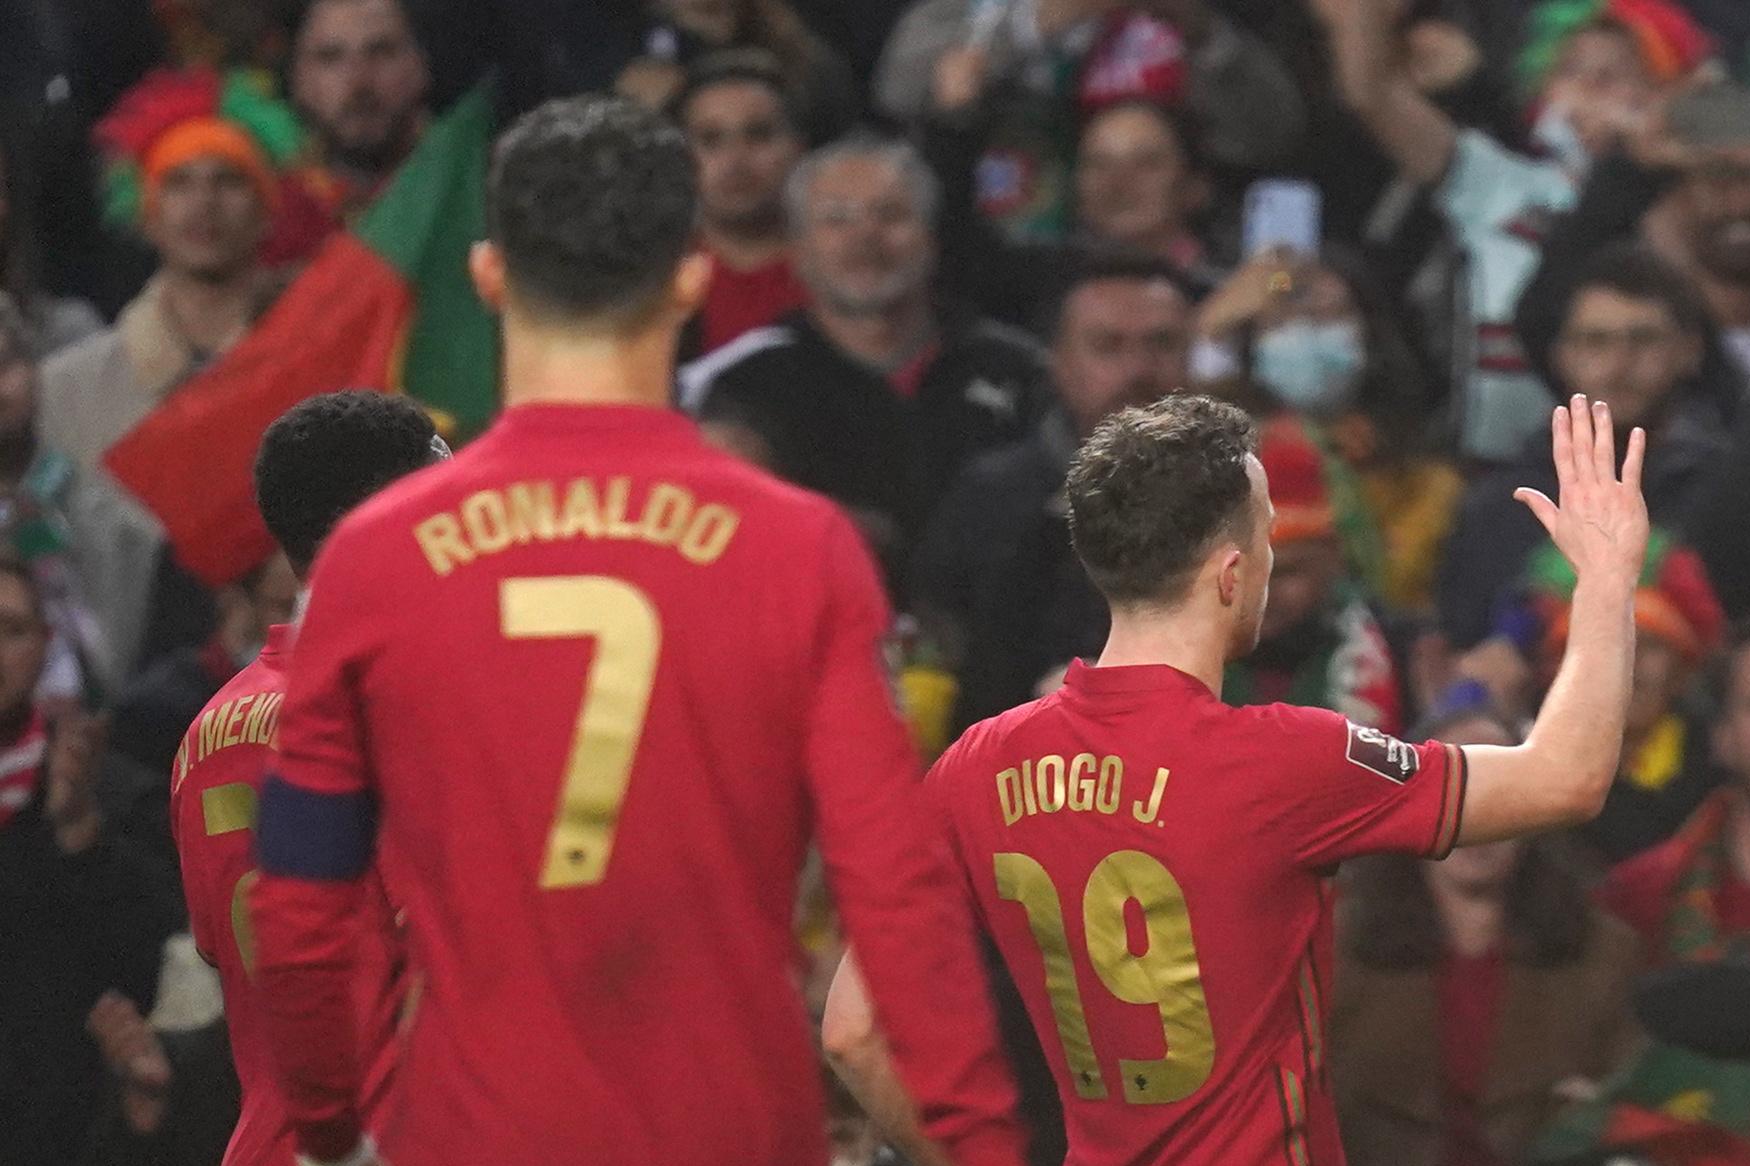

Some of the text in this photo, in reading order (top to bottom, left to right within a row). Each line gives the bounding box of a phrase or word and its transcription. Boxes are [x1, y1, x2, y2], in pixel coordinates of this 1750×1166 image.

[413, 476, 741, 577] RONALDO
[498, 573, 663, 890] 7
[996, 752, 1170, 828] DIOGO J.
[993, 850, 1215, 1104] 19
